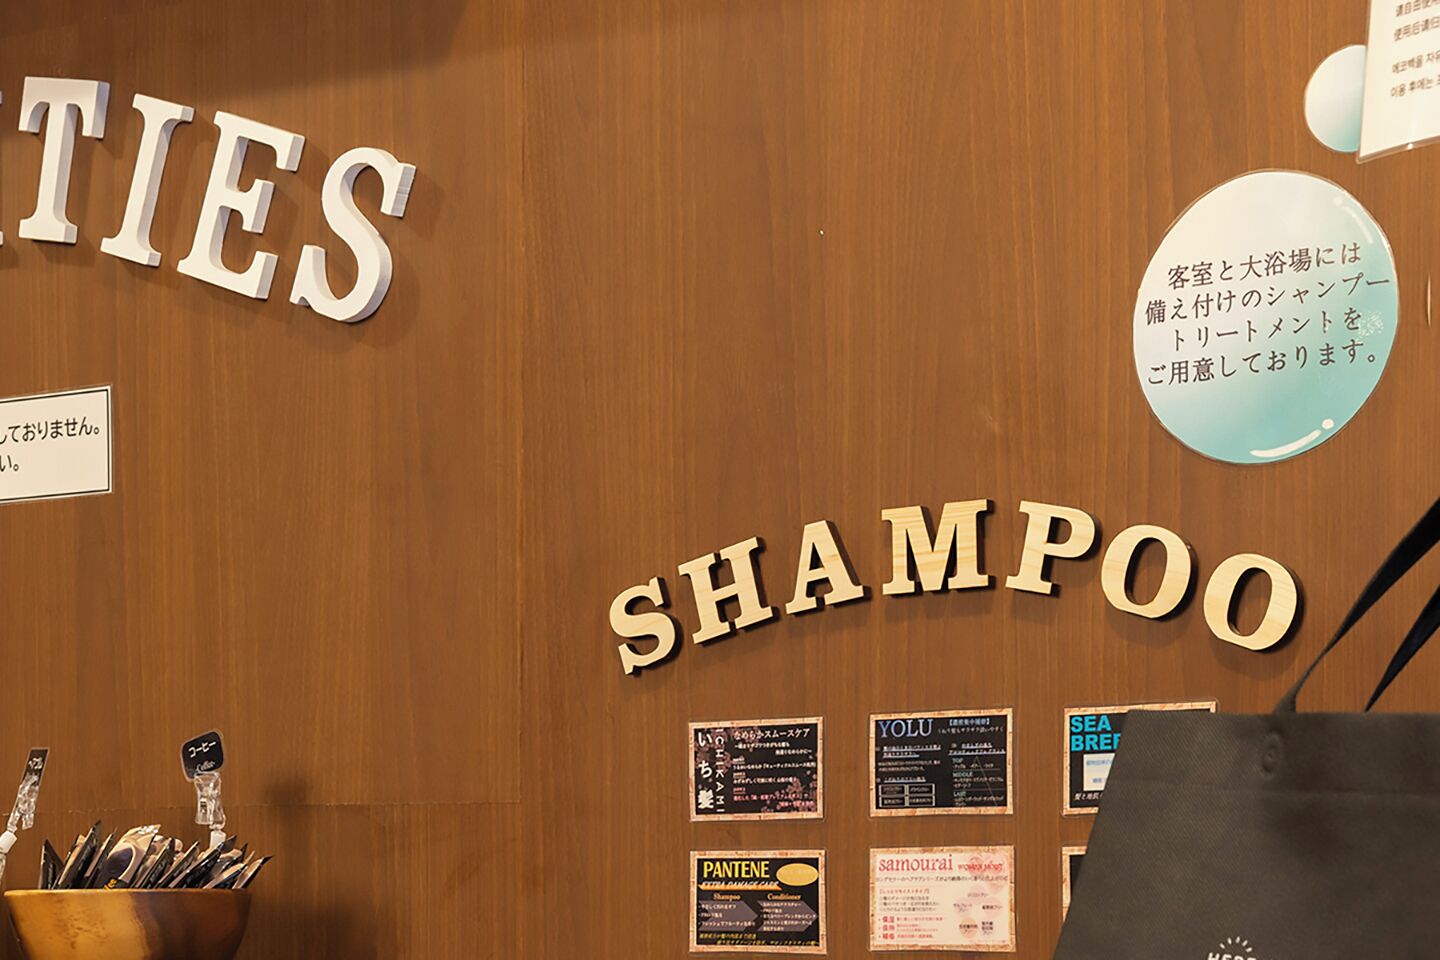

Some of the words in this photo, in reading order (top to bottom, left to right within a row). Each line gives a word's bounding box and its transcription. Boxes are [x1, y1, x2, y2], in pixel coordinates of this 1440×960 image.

[1168, 243, 1361, 290] 客室と大浴場には
[1145, 272, 1390, 325] 備え付けのシャンプー
[1174, 306, 1361, 351] トリートメントを
[1148, 339, 1376, 386] ご用意しております。
[608, 498, 1299, 675] SHAMPOO
[878, 719, 934, 738] YOLU
[1070, 715, 1112, 733] SEA
[188, 741, 216, 758] コーヒー
[698, 732, 714, 809] いち髪
[703, 861, 770, 878] PANTENE
[879, 854, 953, 872] samourai
